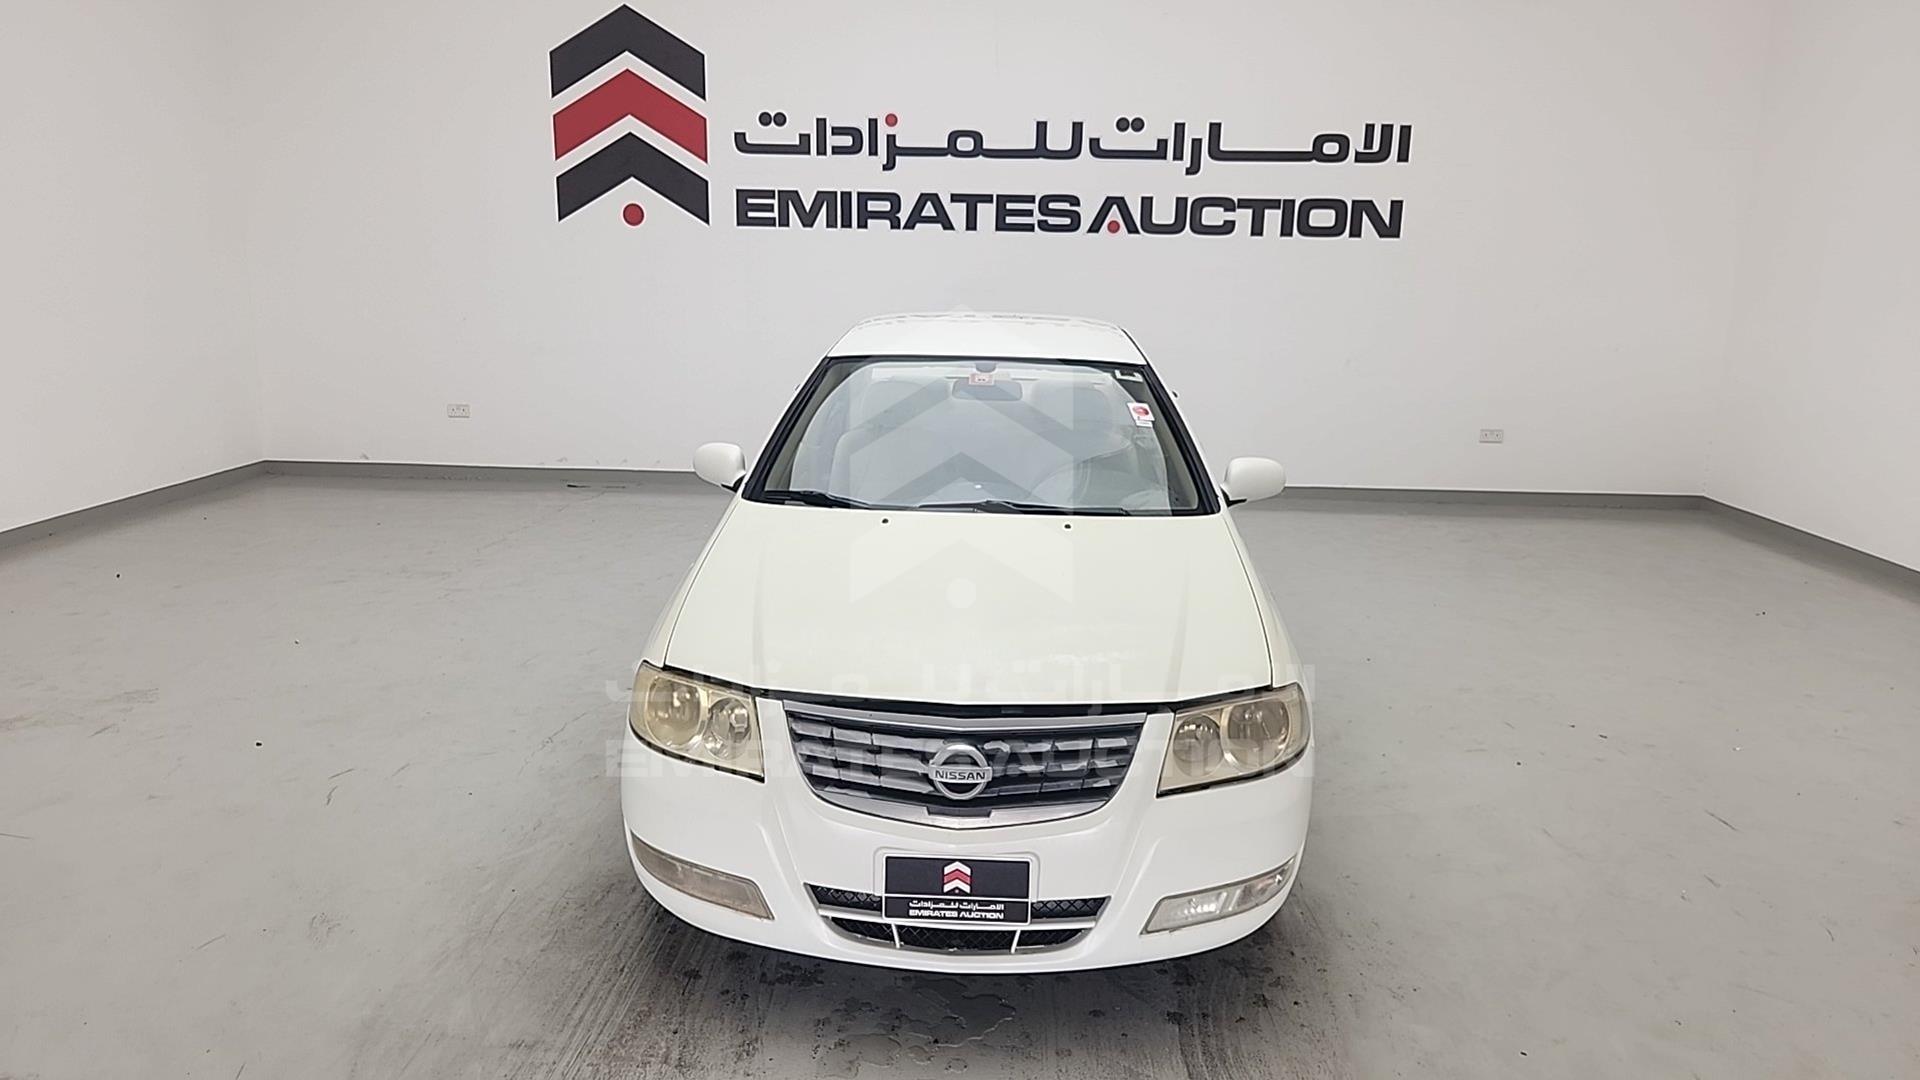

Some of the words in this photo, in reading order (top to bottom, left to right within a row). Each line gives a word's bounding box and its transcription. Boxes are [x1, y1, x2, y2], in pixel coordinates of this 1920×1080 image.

[733, 111, 1084, 172] للمزادات
[1088, 116, 1413, 176] الامارات
[735, 188, 1082, 233] EMIRATES
[1086, 195, 1404, 239] AUCTION
[935, 770, 986, 780] NISSAN
[909, 909, 958, 917] EMIRATES
[960, 911, 1004, 919] AUCTION
